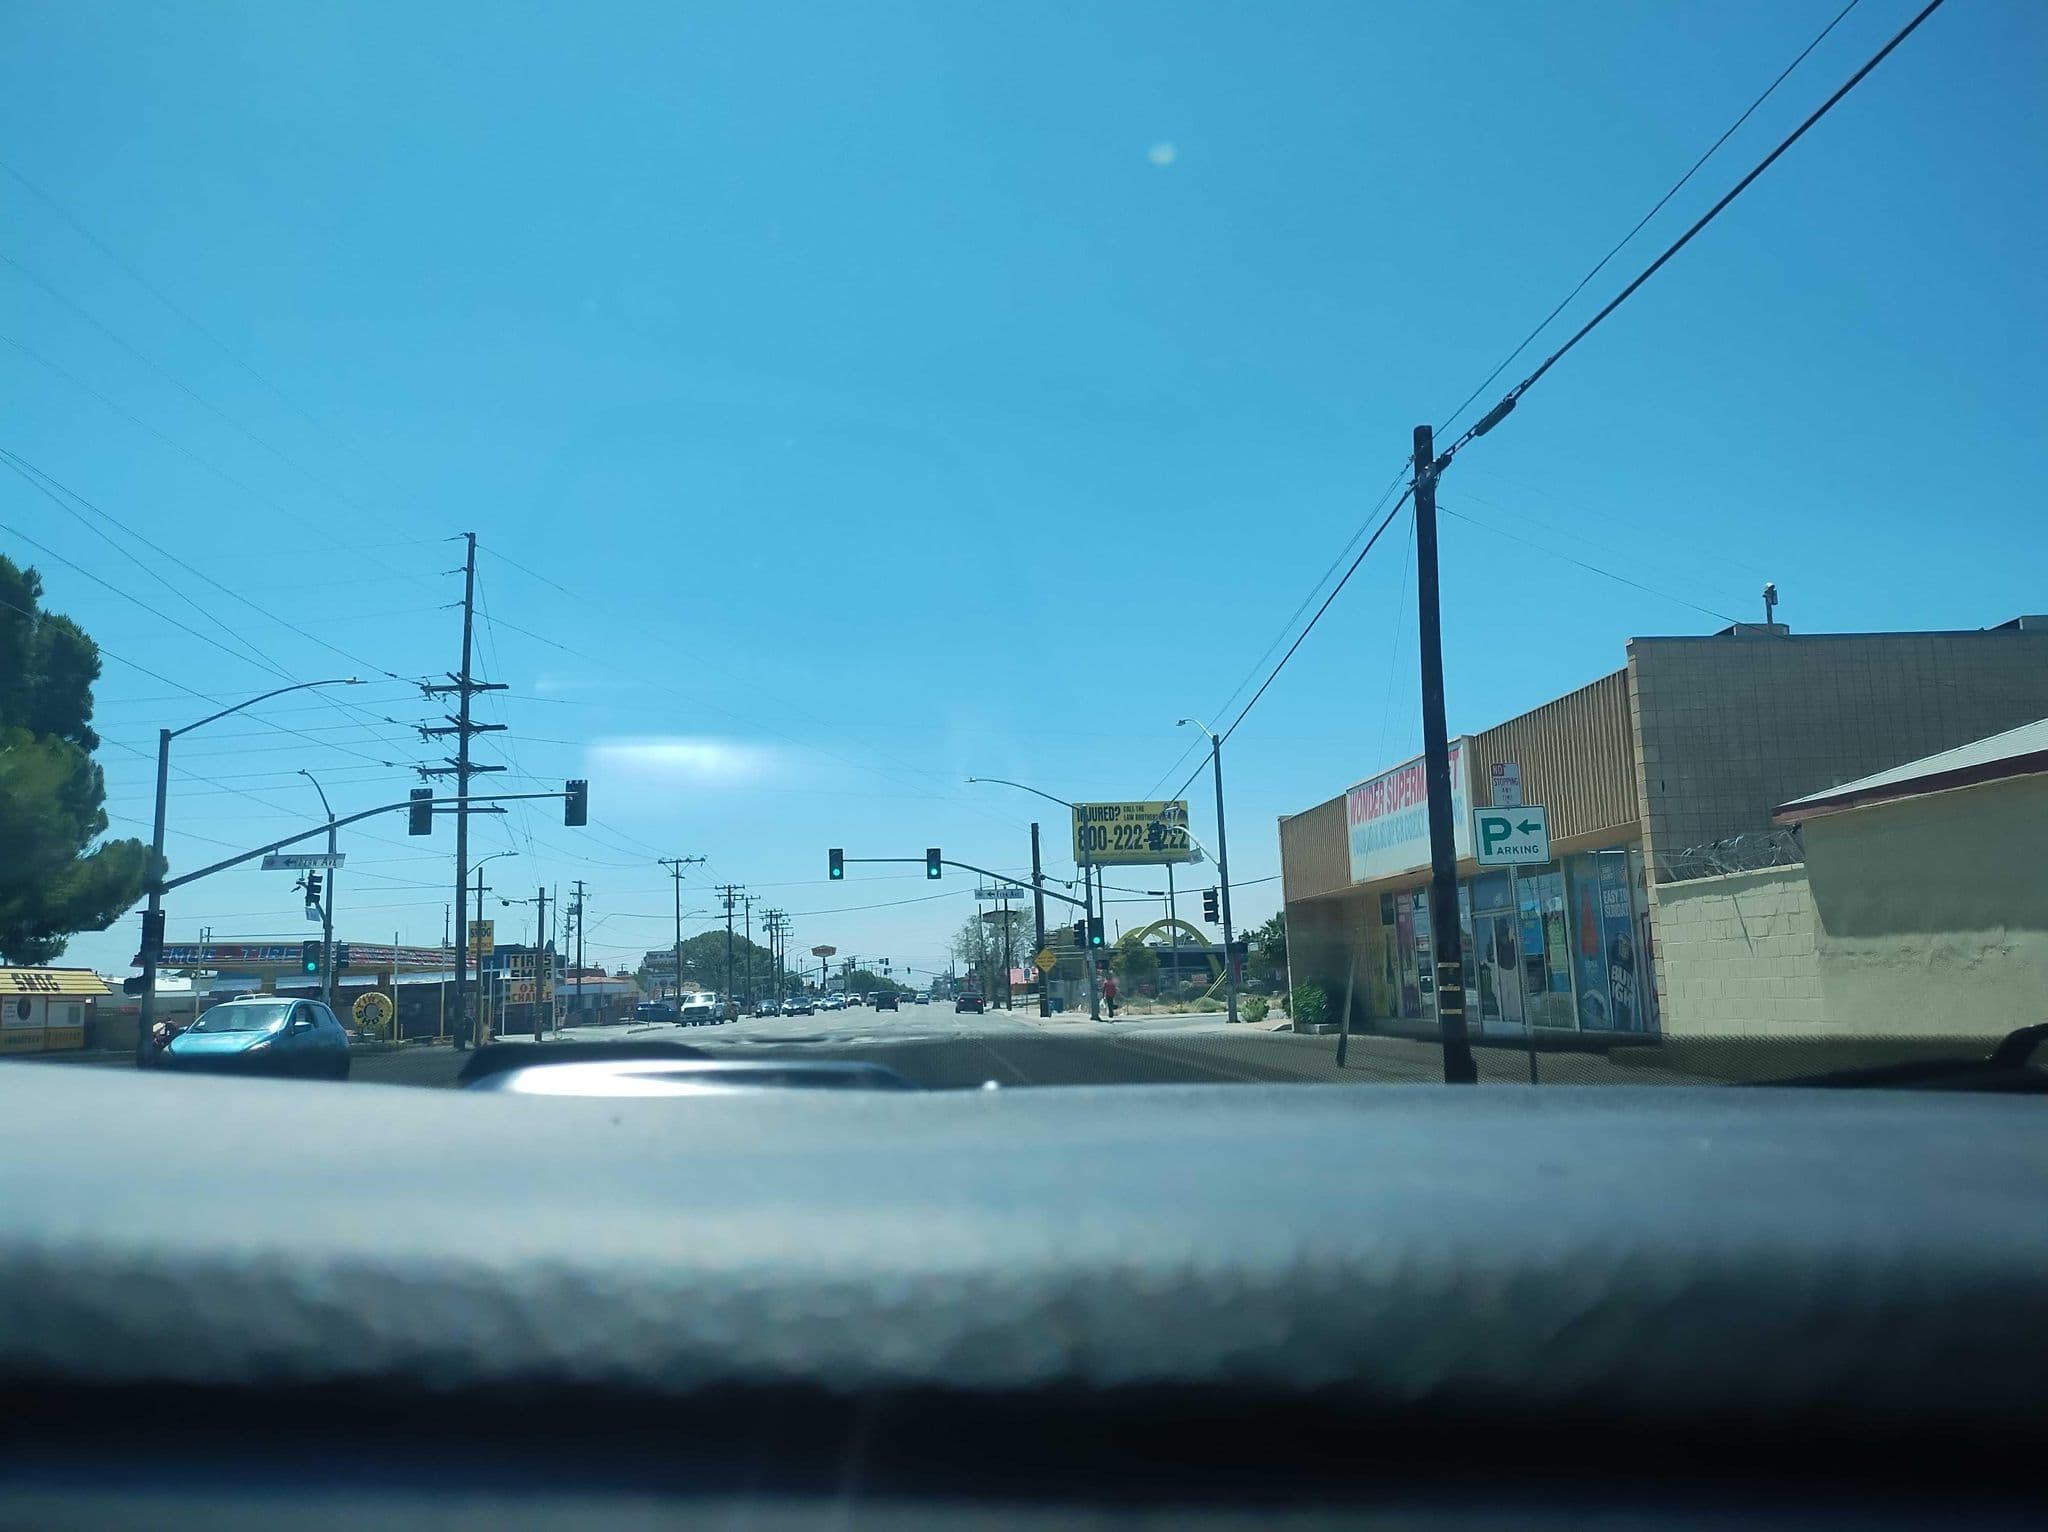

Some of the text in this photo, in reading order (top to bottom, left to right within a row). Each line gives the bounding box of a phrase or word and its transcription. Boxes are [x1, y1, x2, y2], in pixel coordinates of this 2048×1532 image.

[1492, 764, 1503, 775] NO
[1350, 748, 1460, 827] WONDER SUPERMT
[1493, 778, 1519, 786] STOPPING
[1077, 804, 1121, 822] IJURED?
[1078, 823, 1189, 851] 800-222-222
[1481, 817, 1539, 856] PARKING
[511, 992, 553, 1004] CHAE
